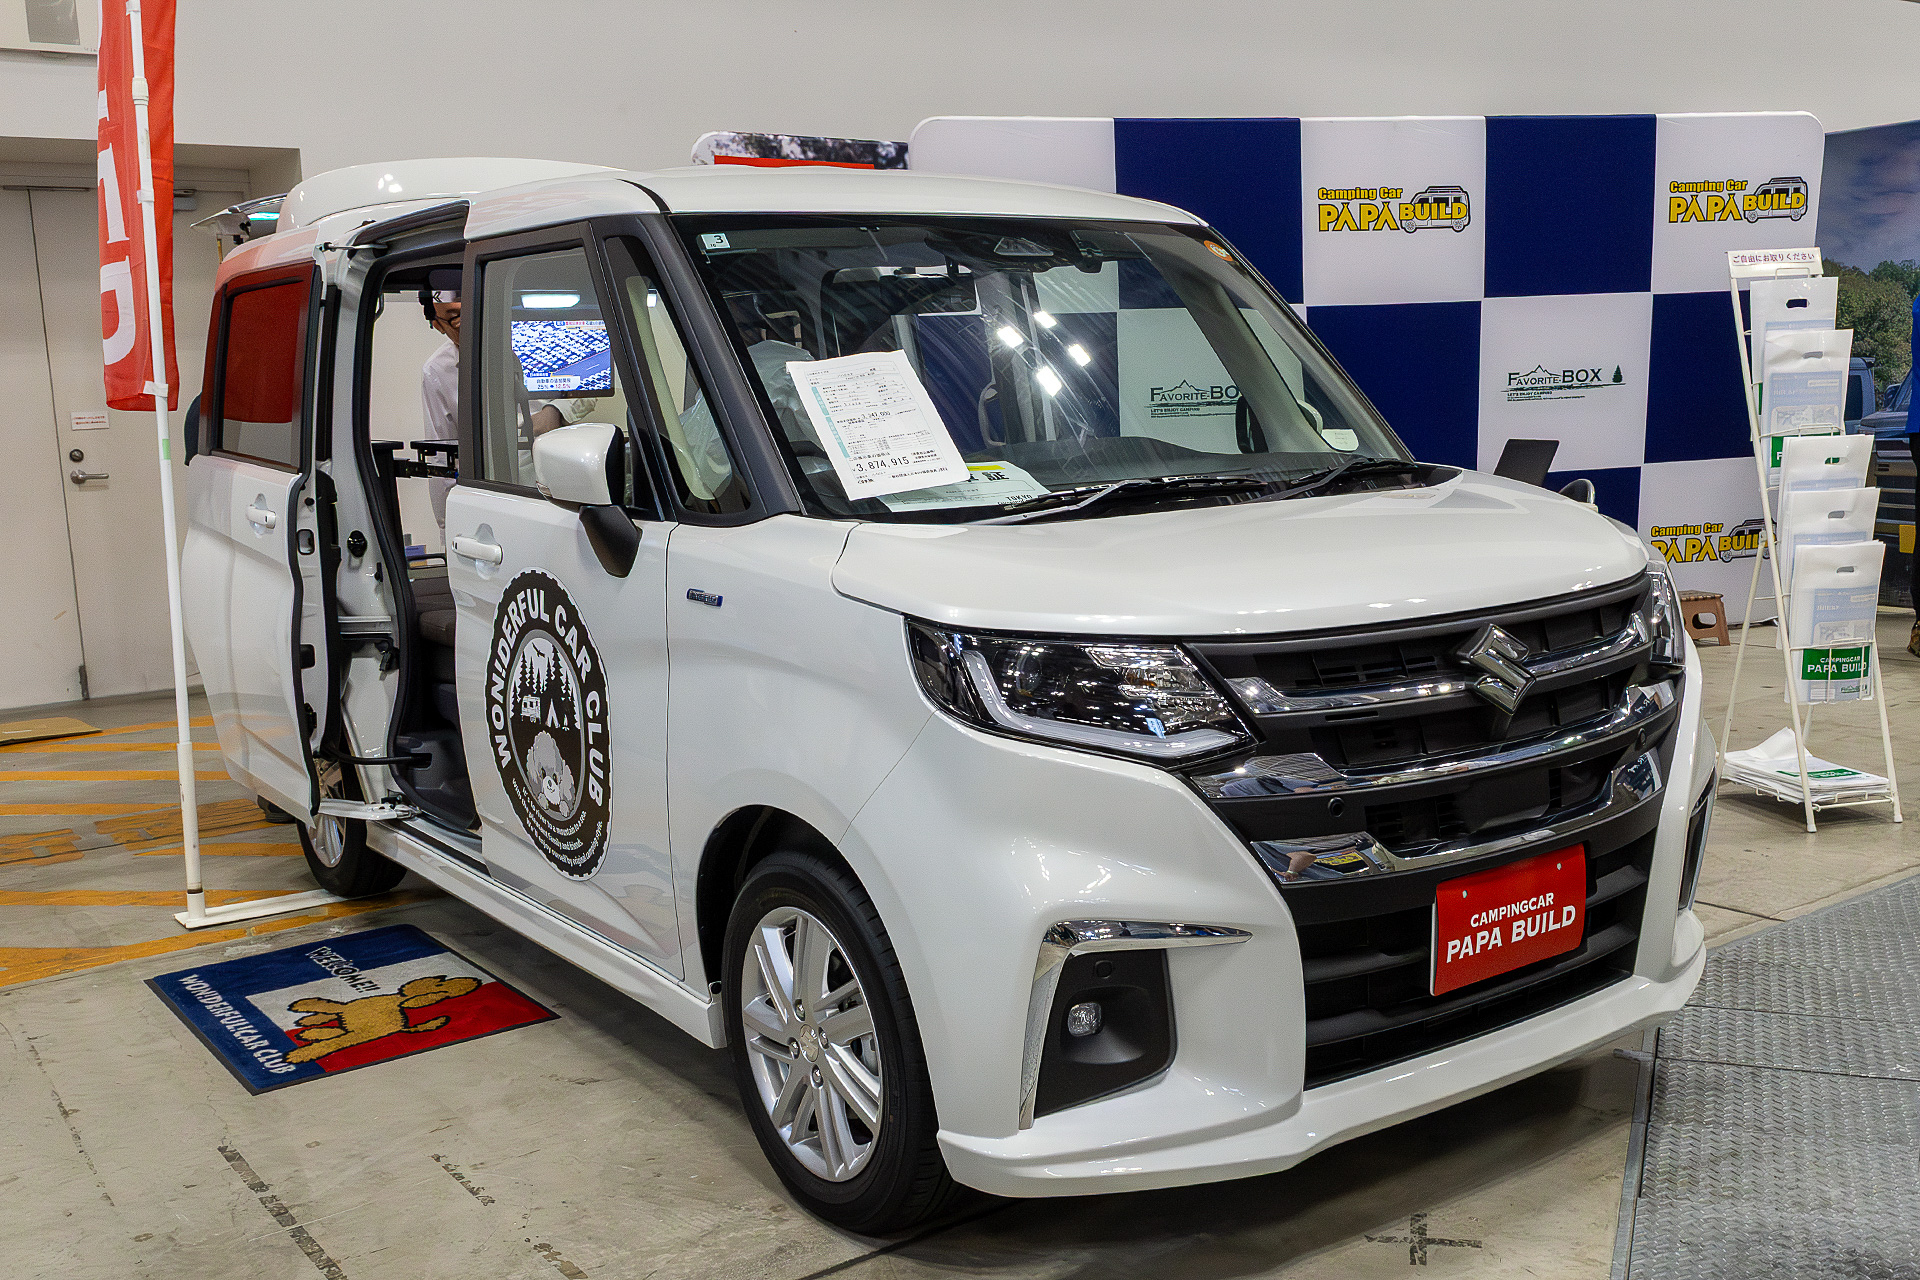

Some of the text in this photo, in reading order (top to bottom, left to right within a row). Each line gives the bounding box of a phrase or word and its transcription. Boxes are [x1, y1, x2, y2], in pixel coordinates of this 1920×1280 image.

[1318, 187, 1403, 200] Camping Car
[1670, 179, 1748, 193] Camping Car
[1318, 201, 1467, 232] PAPA BUILD
[1669, 193, 1805, 223] PAPA BUILD
[714, 235, 724, 243] 3
[1733, 253, 1814, 263] ご自由にお取りください
[1150, 385, 1240, 401] FAVORITE-BO
[1651, 522, 1723, 537] Camping Car
[555, 605, 591, 683] CAR
[586, 690, 604, 806] CLUB
[1470, 893, 1554, 928] CAMPINGCAR
[1446, 905, 1576, 963] PAPA BUILD
[253, 1049, 296, 1074] CLUB
